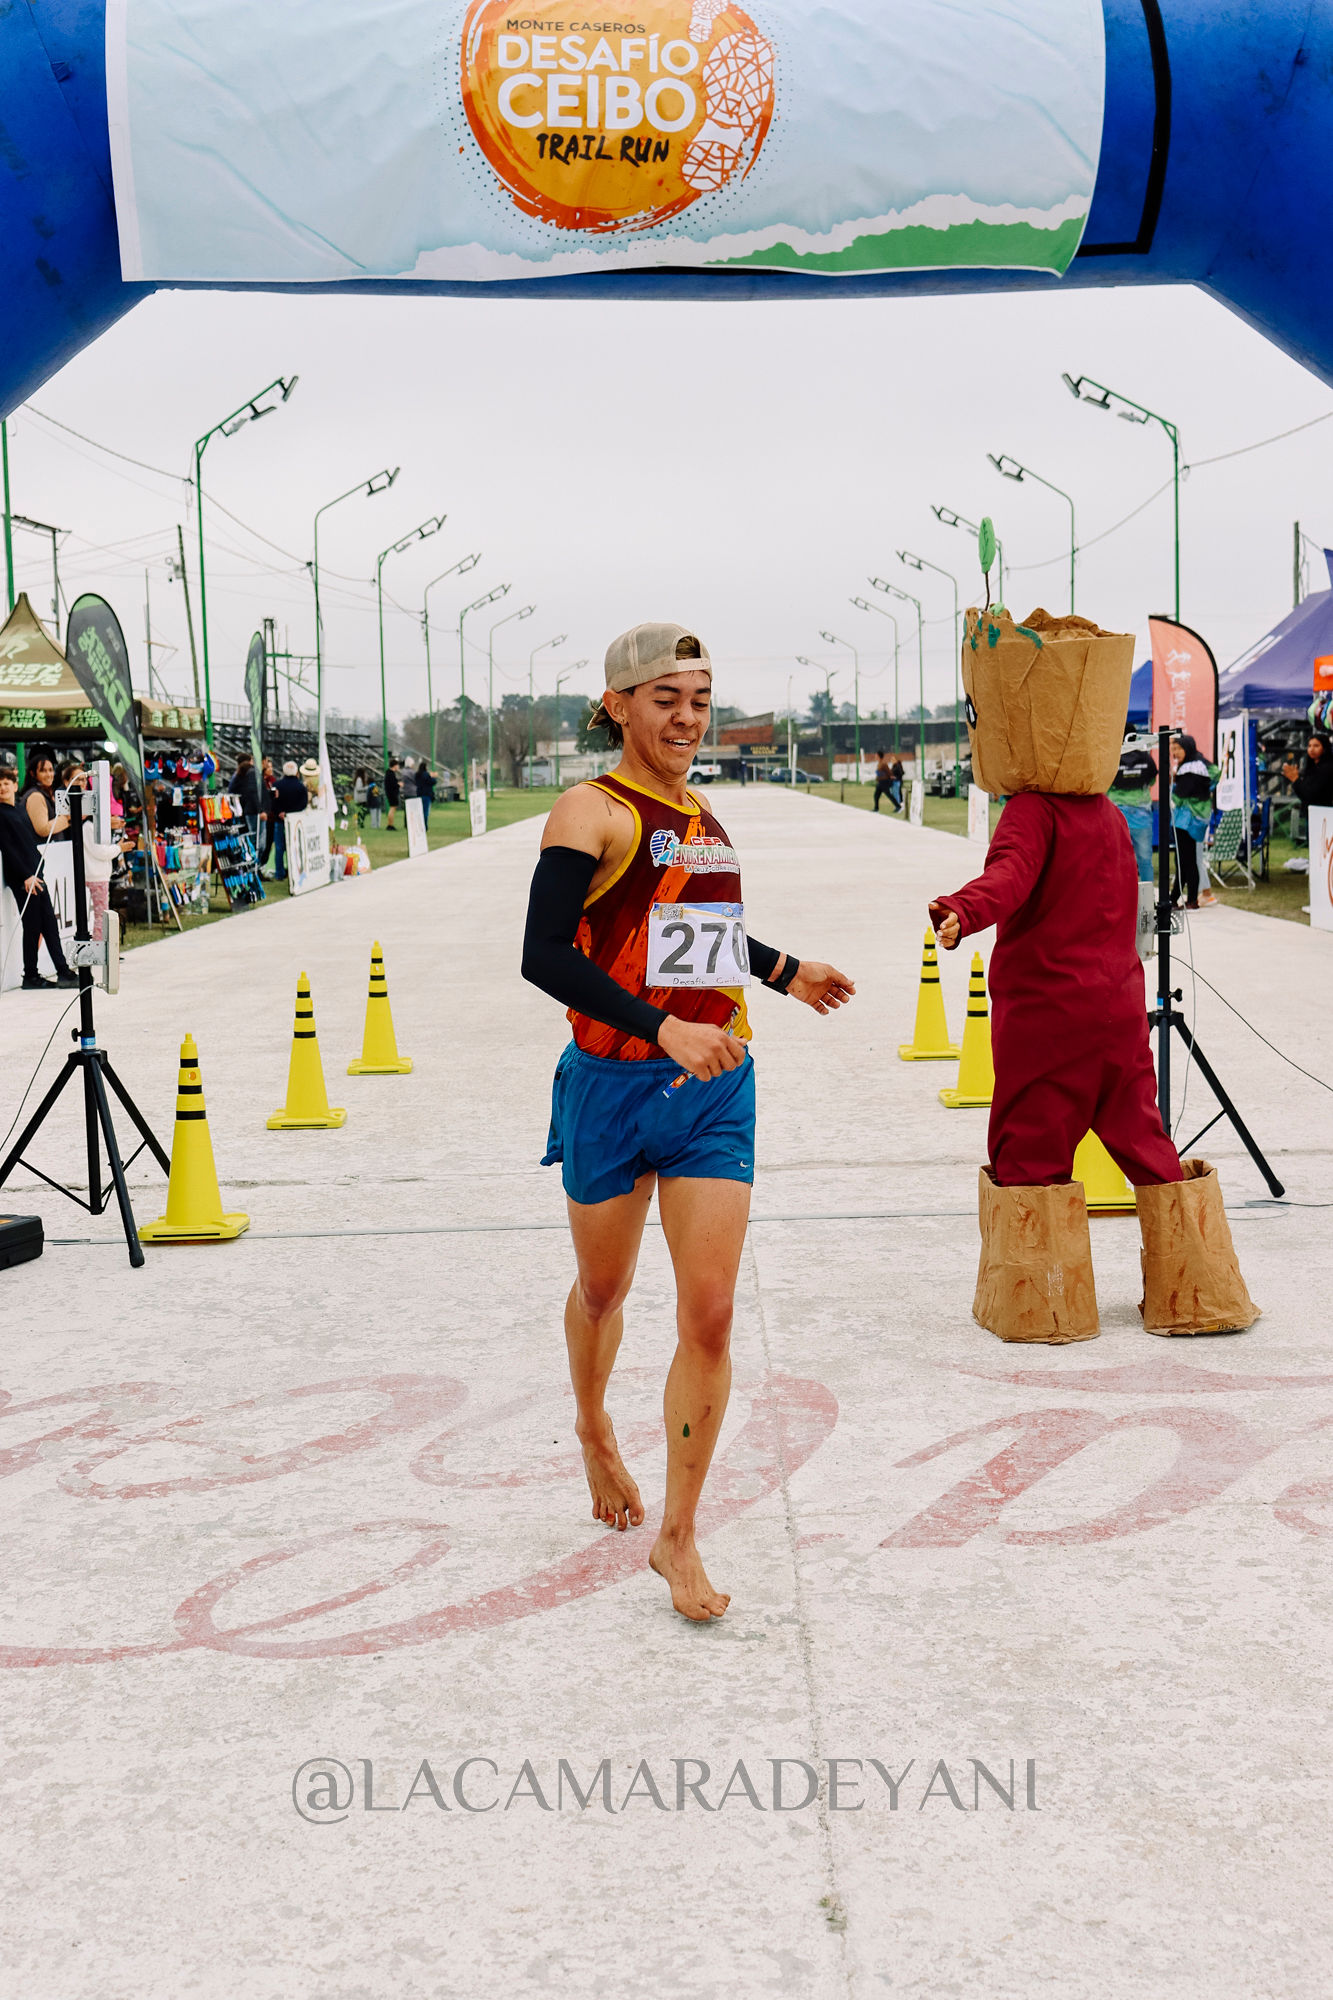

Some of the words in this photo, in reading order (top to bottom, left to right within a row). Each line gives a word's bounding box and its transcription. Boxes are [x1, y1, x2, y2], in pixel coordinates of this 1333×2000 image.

[506, 19, 564, 32] MONTE
[570, 22, 646, 34] CASEROS
[497, 33, 699, 76] DESAFÍO
[497, 73, 697, 133] CEIBO
[536, 133, 613, 165] TRAIL
[619, 136, 670, 167] RUN
[658, 921, 748, 974] 270
